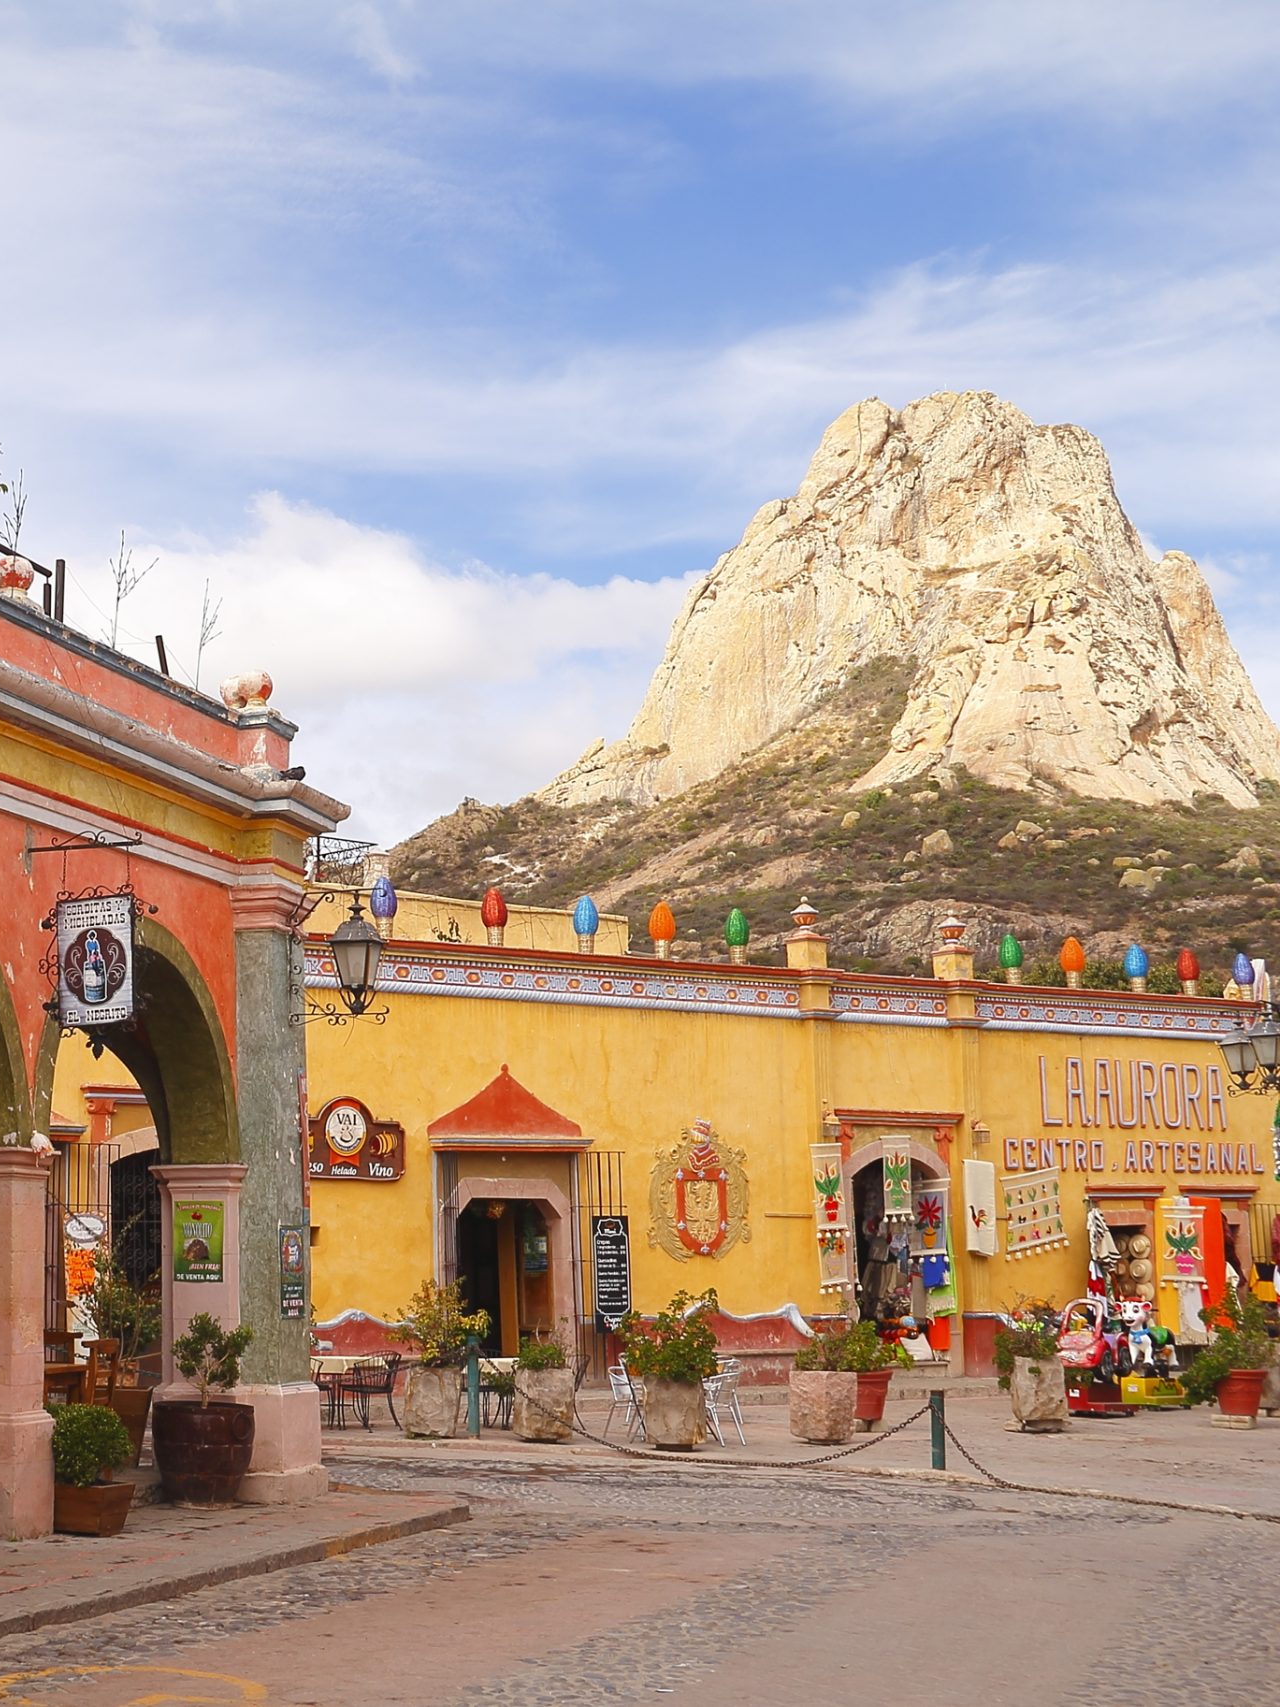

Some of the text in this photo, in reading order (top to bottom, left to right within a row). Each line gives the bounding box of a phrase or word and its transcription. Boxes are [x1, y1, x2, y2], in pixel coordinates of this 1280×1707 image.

[64, 912, 126, 930] MICHELADAS
[67, 1007, 128, 1024] EL NEGRITO
[1038, 1055, 1228, 1131] LA AURORA
[336, 1113, 357, 1126] VAI
[1003, 1137, 1265, 1175] CENTRO ARTESANAL
[331, 1166, 357, 1176] Helado
[368, 1162, 394, 1177] Vino
